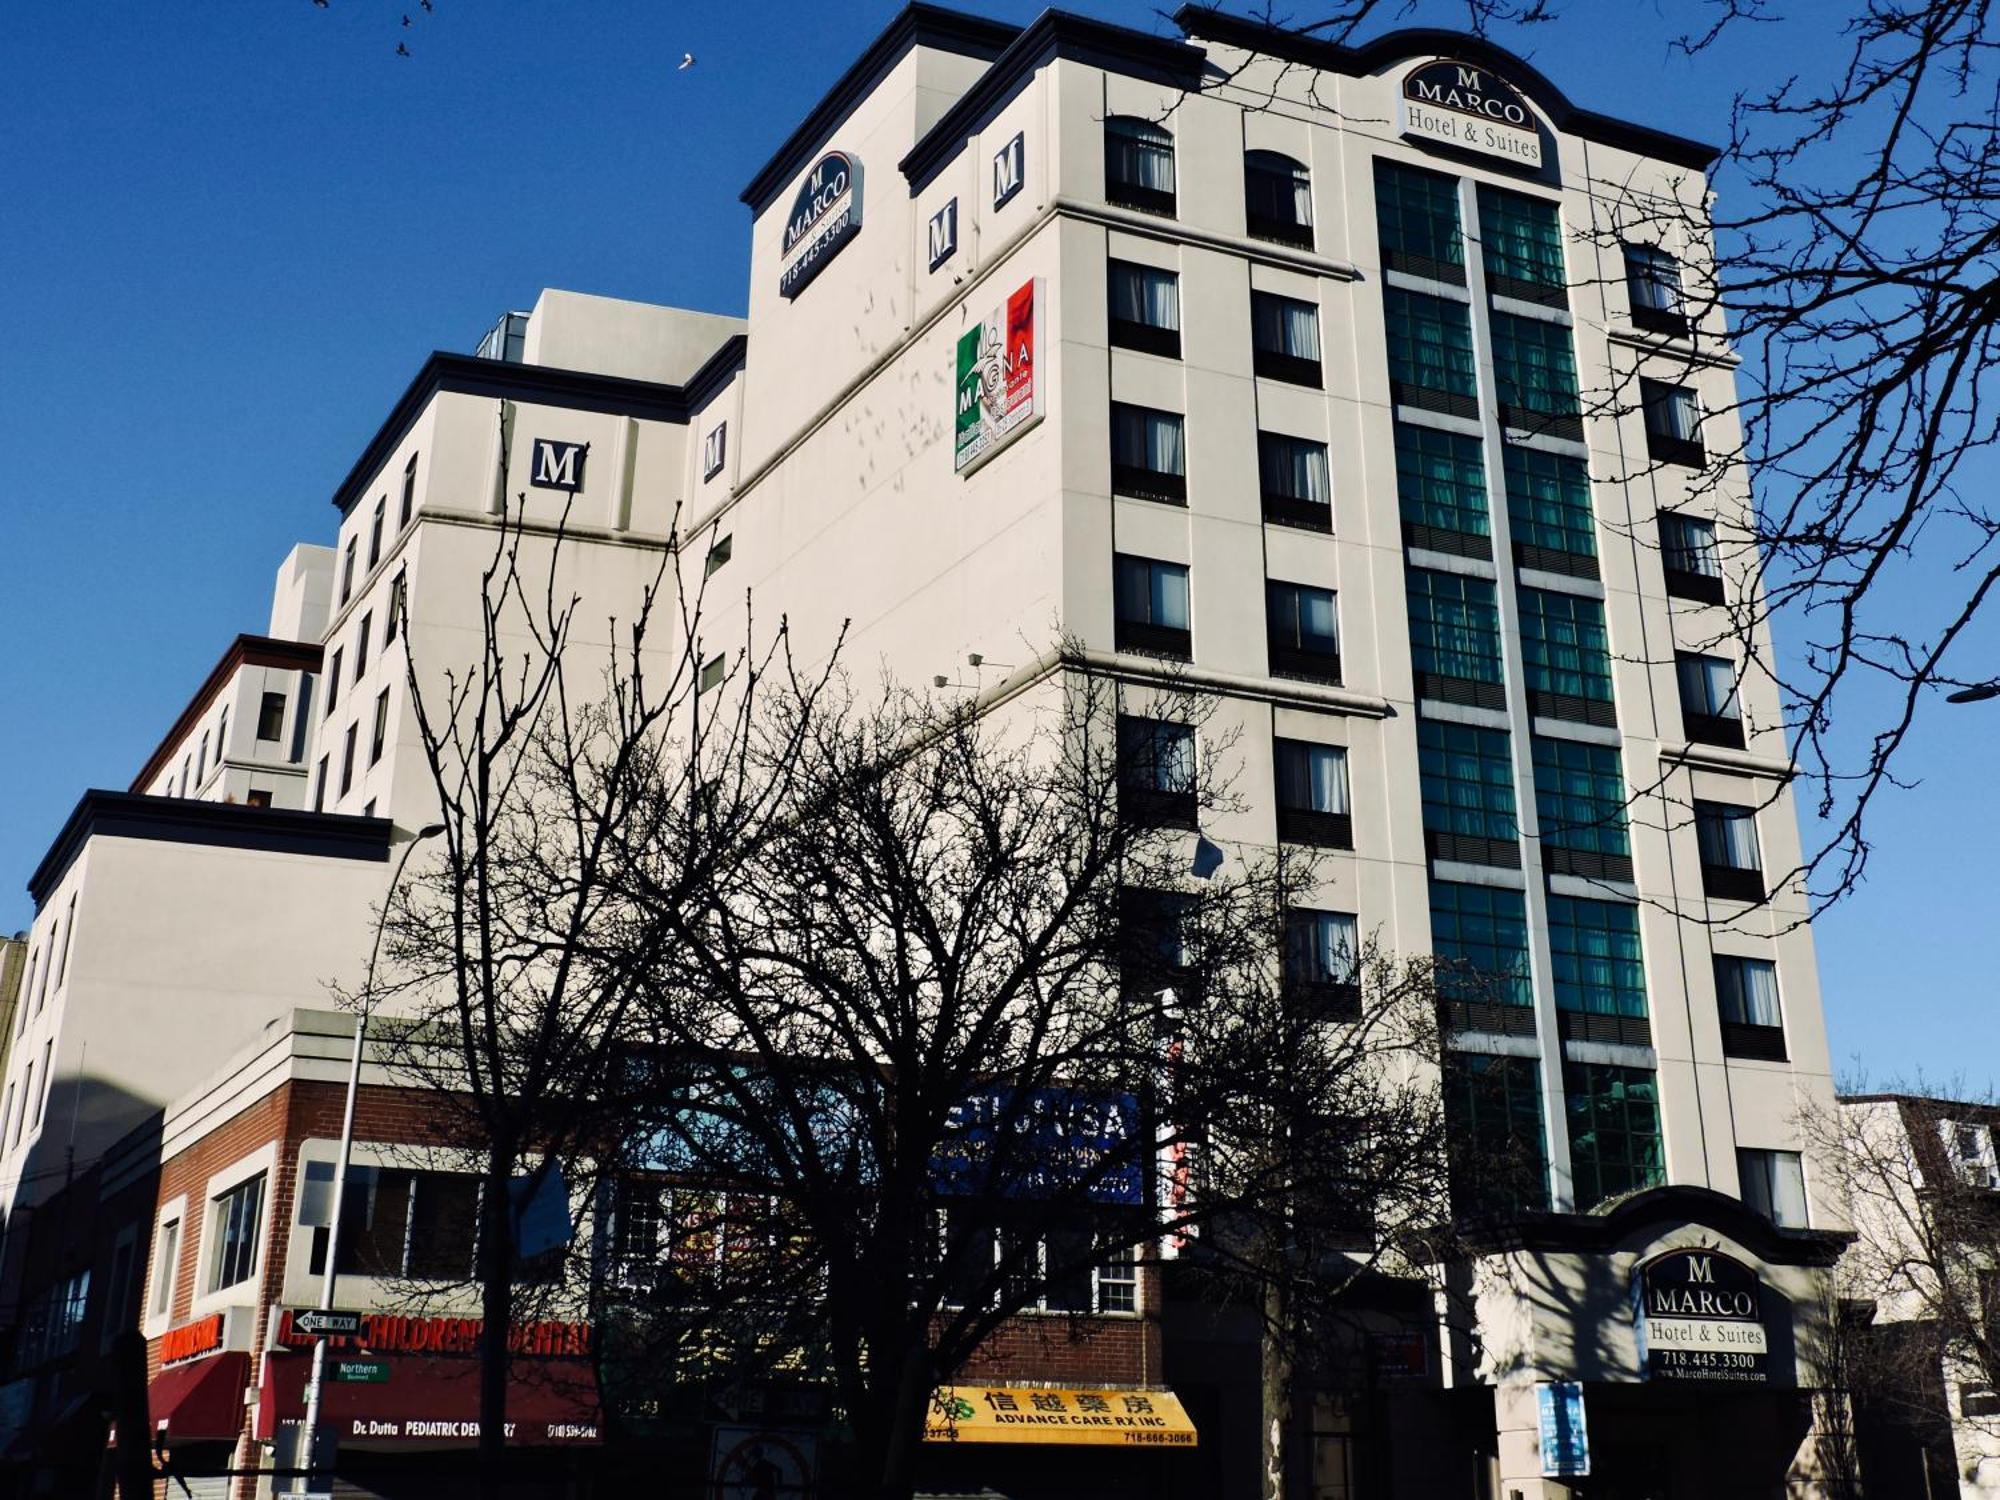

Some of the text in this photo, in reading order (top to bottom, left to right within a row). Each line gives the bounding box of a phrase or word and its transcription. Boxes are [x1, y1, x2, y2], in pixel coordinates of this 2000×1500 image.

[1456, 66, 1482, 92] M
[1416, 79, 1525, 124] MARCO
[1408, 106, 1538, 159] Hotel & Suites
[810, 165, 824, 196] M
[994, 138, 1020, 202] M
[787, 171, 846, 249] MARCO
[930, 204, 953, 265] M
[782, 211, 850, 291] 718-445-3300
[535, 442, 579, 486] M
[1687, 1255, 1715, 1283] M
[1656, 1289, 1752, 1316] MARCO
[303, 1317, 352, 1329] ONE WAY
[1650, 1322, 1763, 1345] Hotel & Suites
[340, 1362, 378, 1375] Northern
[1663, 1351, 1755, 1369] 718.445.3300
[353, 1420, 367, 1435] Dr.
[369, 1420, 398, 1436] Dutta
[405, 1421, 459, 1437] PEDIATRIC
[995, 1413, 1166, 1427] ADVANCE CARE RX INC
